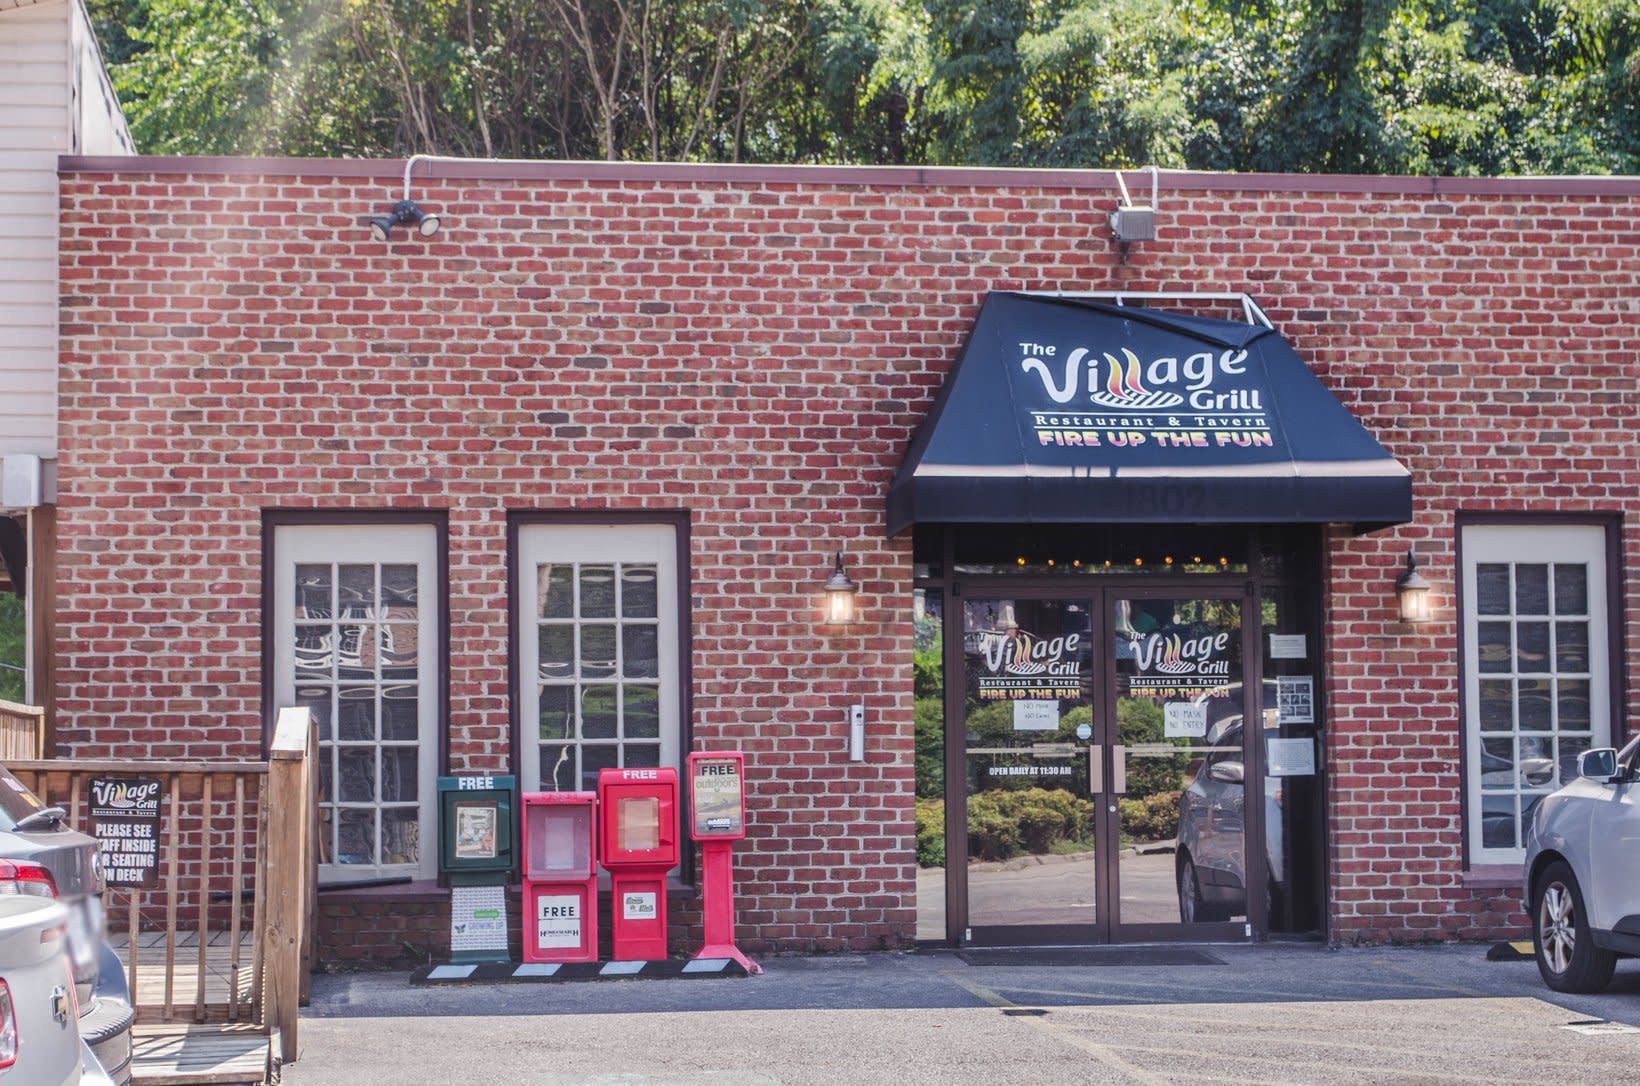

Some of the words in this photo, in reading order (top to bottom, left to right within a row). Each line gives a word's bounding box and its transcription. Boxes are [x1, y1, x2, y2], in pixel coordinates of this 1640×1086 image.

[1019, 342, 1056, 356] The
[1021, 347, 1248, 403] Village
[1189, 390, 1263, 410] Grill
[1034, 415, 1154, 426] Restaurant
[1168, 416, 1181, 427] &
[1194, 416, 1266, 427] Tavern
[1037, 430, 1102, 447] FIRE
[1106, 431, 1147, 447] UP
[1151, 431, 1210, 447] THE
[1215, 431, 1273, 448] FUN
[1130, 631, 1146, 640] The
[978, 633, 1080, 672] Village
[1128, 632, 1229, 671] Village
[1047, 661, 1080, 675] Grill
[1197, 660, 1229, 674] Grill
[979, 689, 1007, 699] FIRE
[1009, 689, 1026, 699] UP
[1028, 689, 1053, 699] THE
[1055, 689, 1080, 699] FUN
[1129, 687, 1157, 698] FIRE
[1160, 687, 1176, 698] UP
[1177, 687, 1202, 698] THE
[623, 770, 657, 780] FREE
[702, 765, 735, 776] FREE
[989, 767, 1008, 776] OPEN
[1009, 767, 1029, 775] DAILY
[1029, 766, 1039, 775] AT
[1040, 766, 1059, 775] 11:30
[1060, 766, 1072, 775] AM
[458, 777, 495, 790] FREE
[92, 782, 158, 806] Village
[136, 800, 158, 809] Grill
[95, 823, 132, 837] PLEASE
[133, 824, 152, 837] SEE
[99, 839, 120, 852] TAFF
[121, 839, 156, 852] INSIDE
[112, 853, 154, 867] SEATING
[116, 868, 144, 881] DECK
[543, 906, 575, 917] FREE
